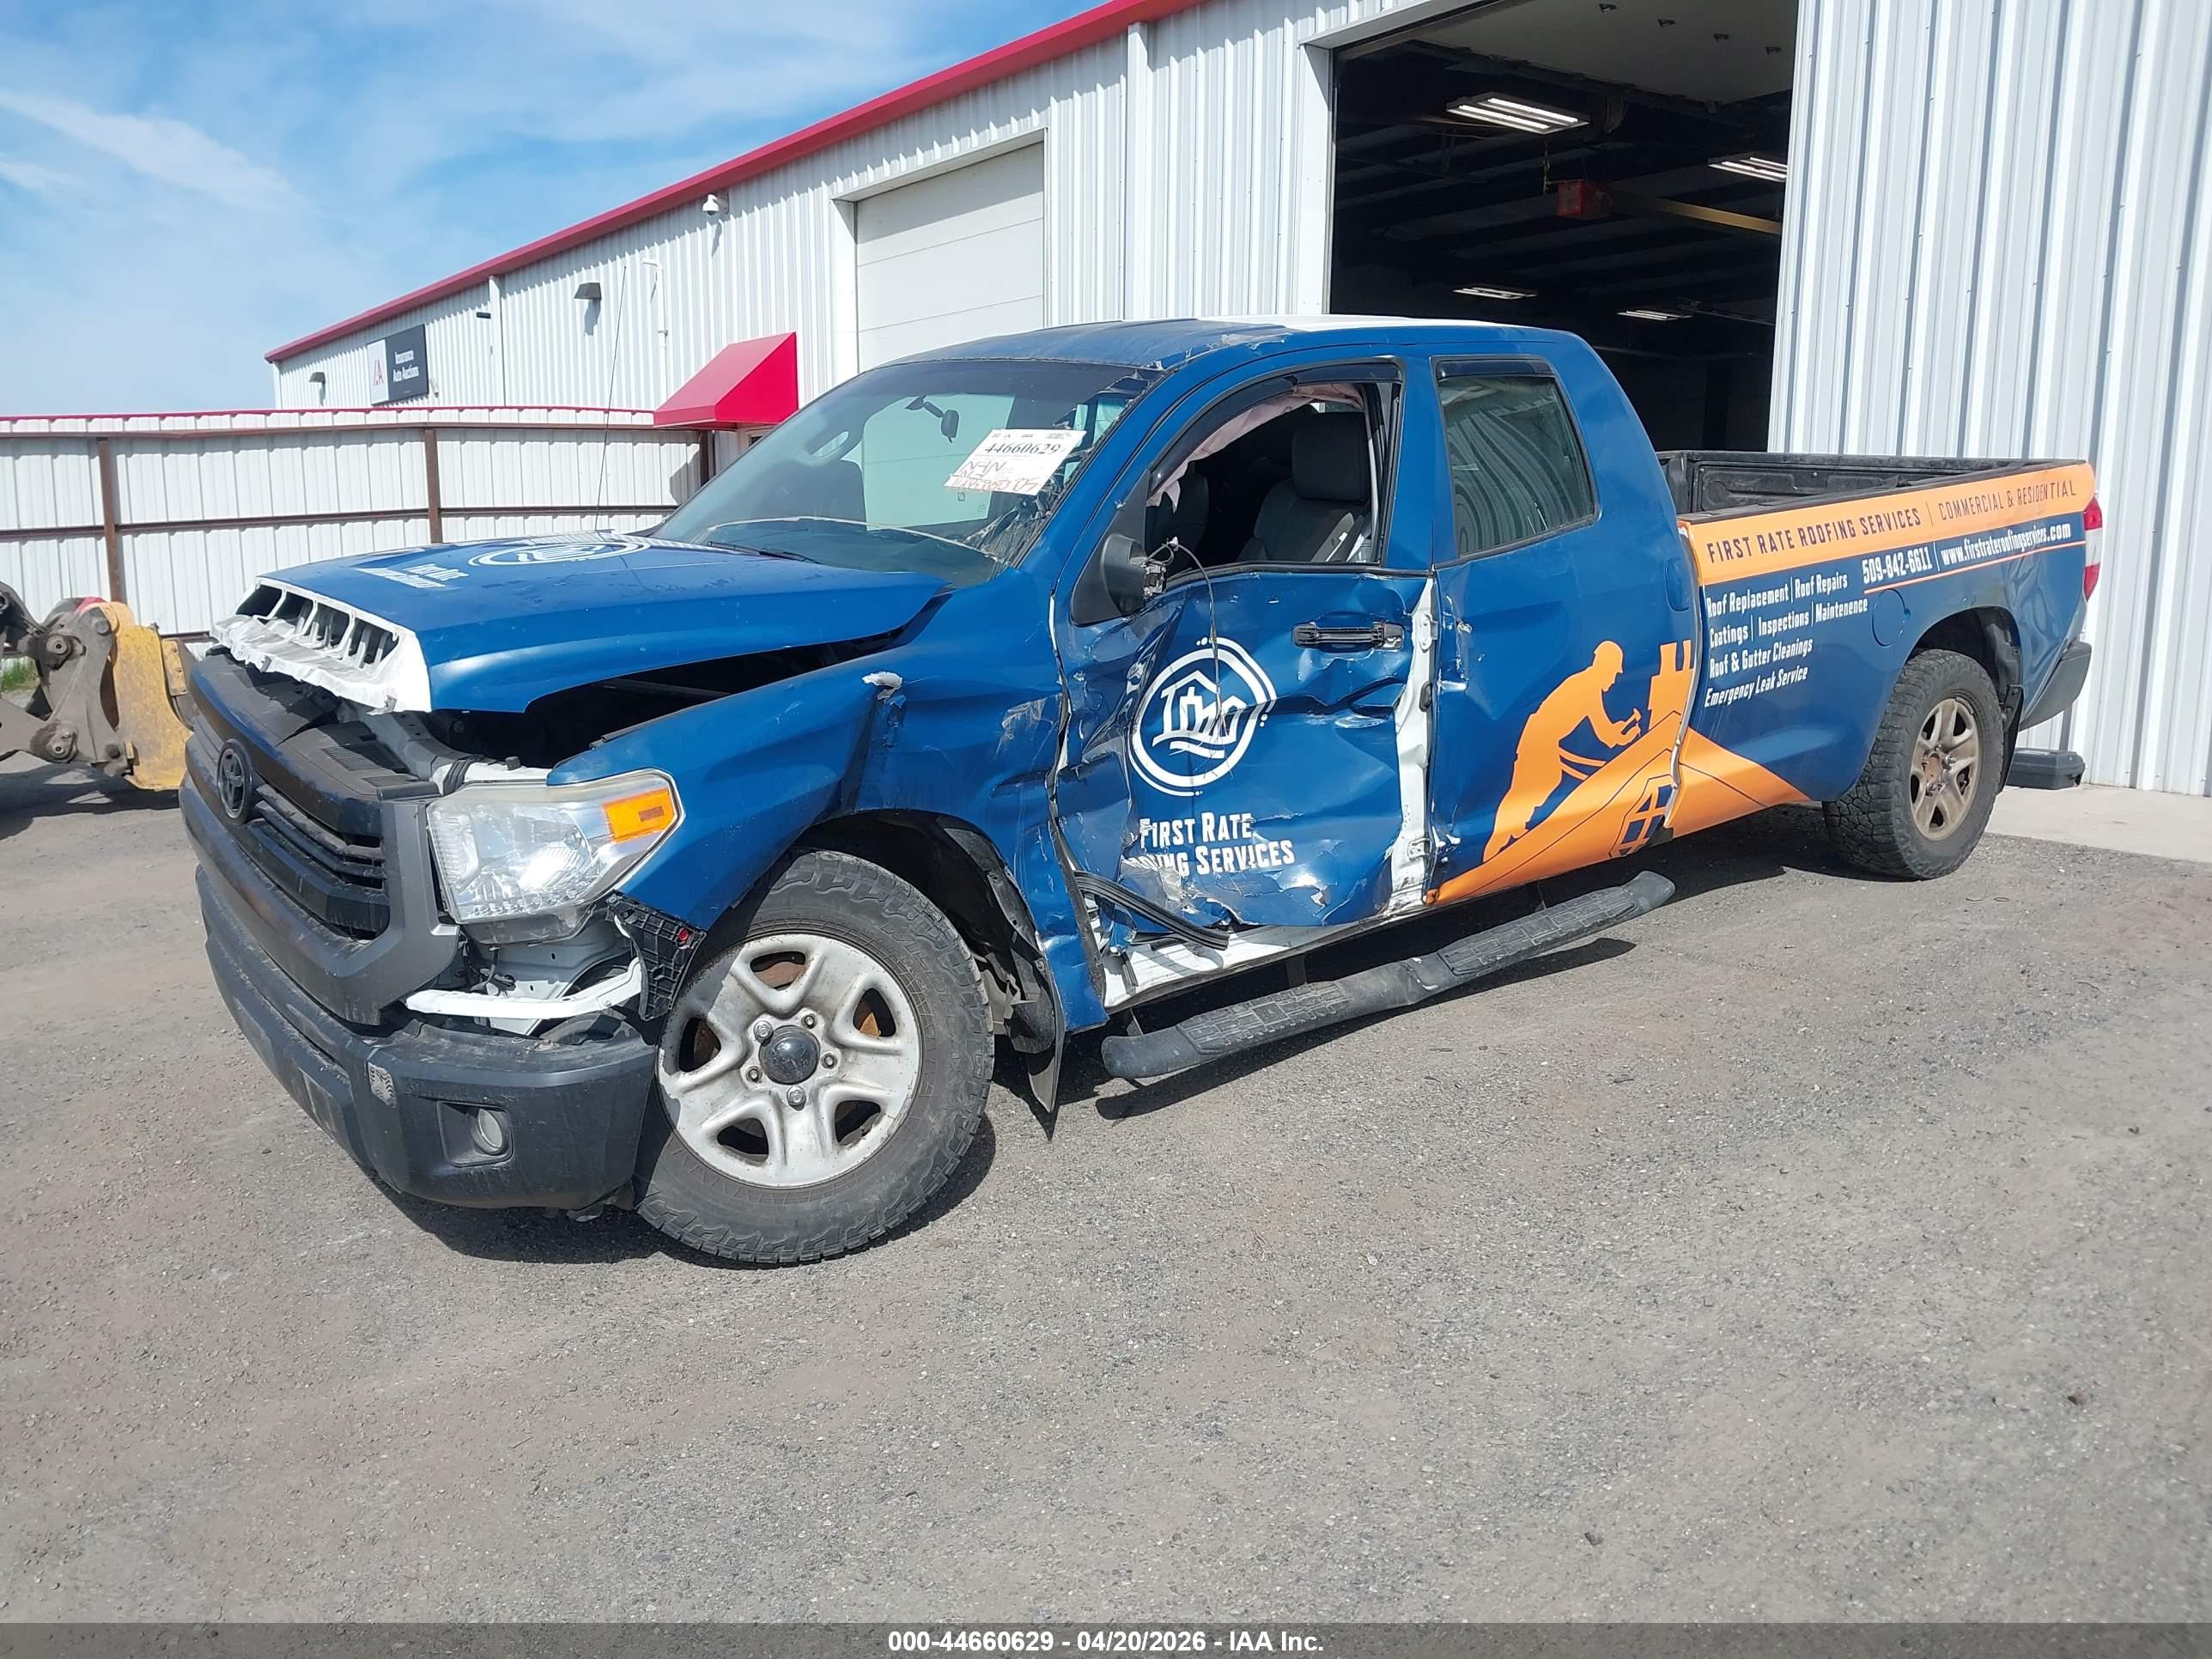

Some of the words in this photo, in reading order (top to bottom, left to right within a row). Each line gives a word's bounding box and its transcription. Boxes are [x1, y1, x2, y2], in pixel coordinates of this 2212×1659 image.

[984, 442, 1061, 454] 44660629
[1706, 537, 1752, 563] FIRST
[1756, 530, 1795, 554] RATE
[1797, 520, 1856, 546] ROOFING
[1859, 507, 1921, 535] SERVICES
[1938, 492, 2004, 520] COMMERCIAL
[2007, 490, 2014, 508] &
[2017, 480, 2077, 506] RESIDENTIAL
[1706, 593, 1728, 618] Roof
[1729, 583, 1790, 617] Replacement
[1795, 575, 1814, 599] Roof
[1816, 572, 1848, 595] Repairs
[1710, 622, 1748, 649] Coatings
[1759, 611, 1809, 636] Inspections
[1815, 598, 1869, 623] Maintenence
[1710, 653, 1728, 679] Roof
[1731, 652, 1740, 672] &
[1742, 647, 1771, 671] Gutter
[1772, 637, 1814, 662] Cleanings
[1705, 682, 1755, 708] Emergency
[1755, 674, 1776, 695] Leak
[1777, 665, 1808, 688] Service
[1139, 818, 1196, 849] FIRST
[1201, 811, 1253, 842] RATE
[1195, 840, 1295, 875] SERVICES
